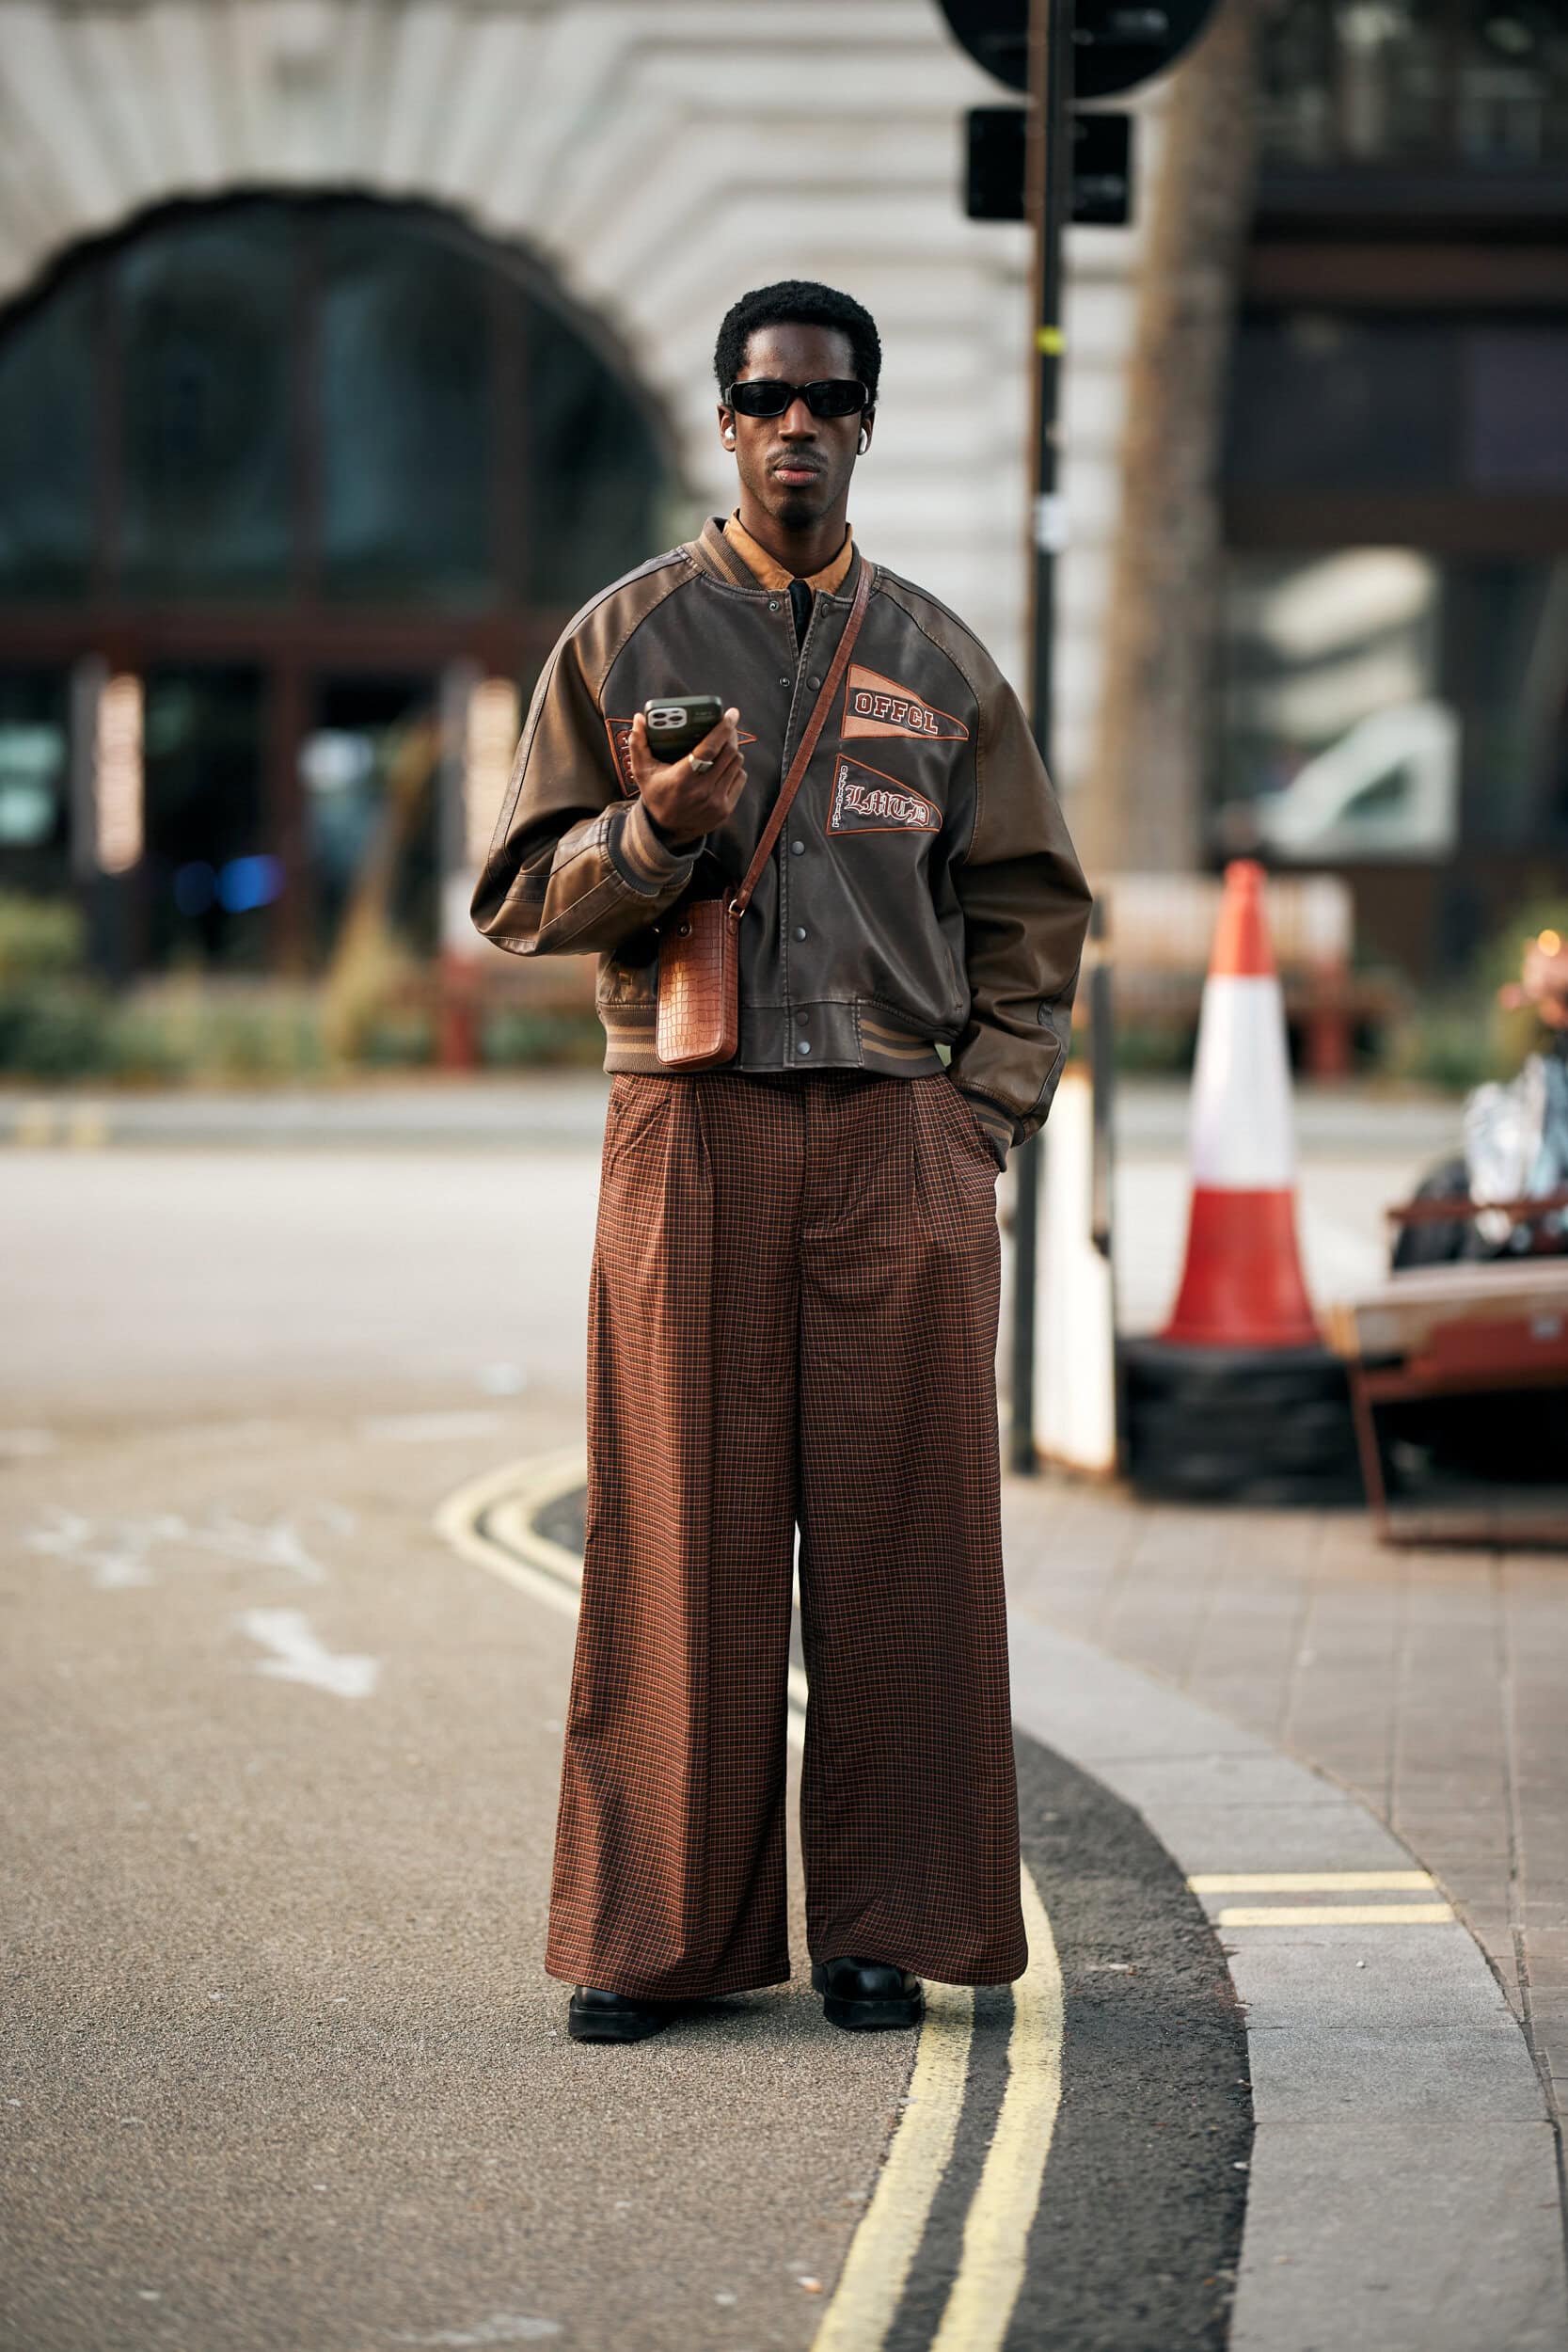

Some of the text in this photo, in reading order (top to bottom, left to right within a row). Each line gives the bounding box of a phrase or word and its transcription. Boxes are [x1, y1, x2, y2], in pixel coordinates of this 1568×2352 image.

[855, 692, 939, 735] OFFCL
[832, 766, 848, 828] OFFICIAL
[844, 785, 930, 827] LMTD
